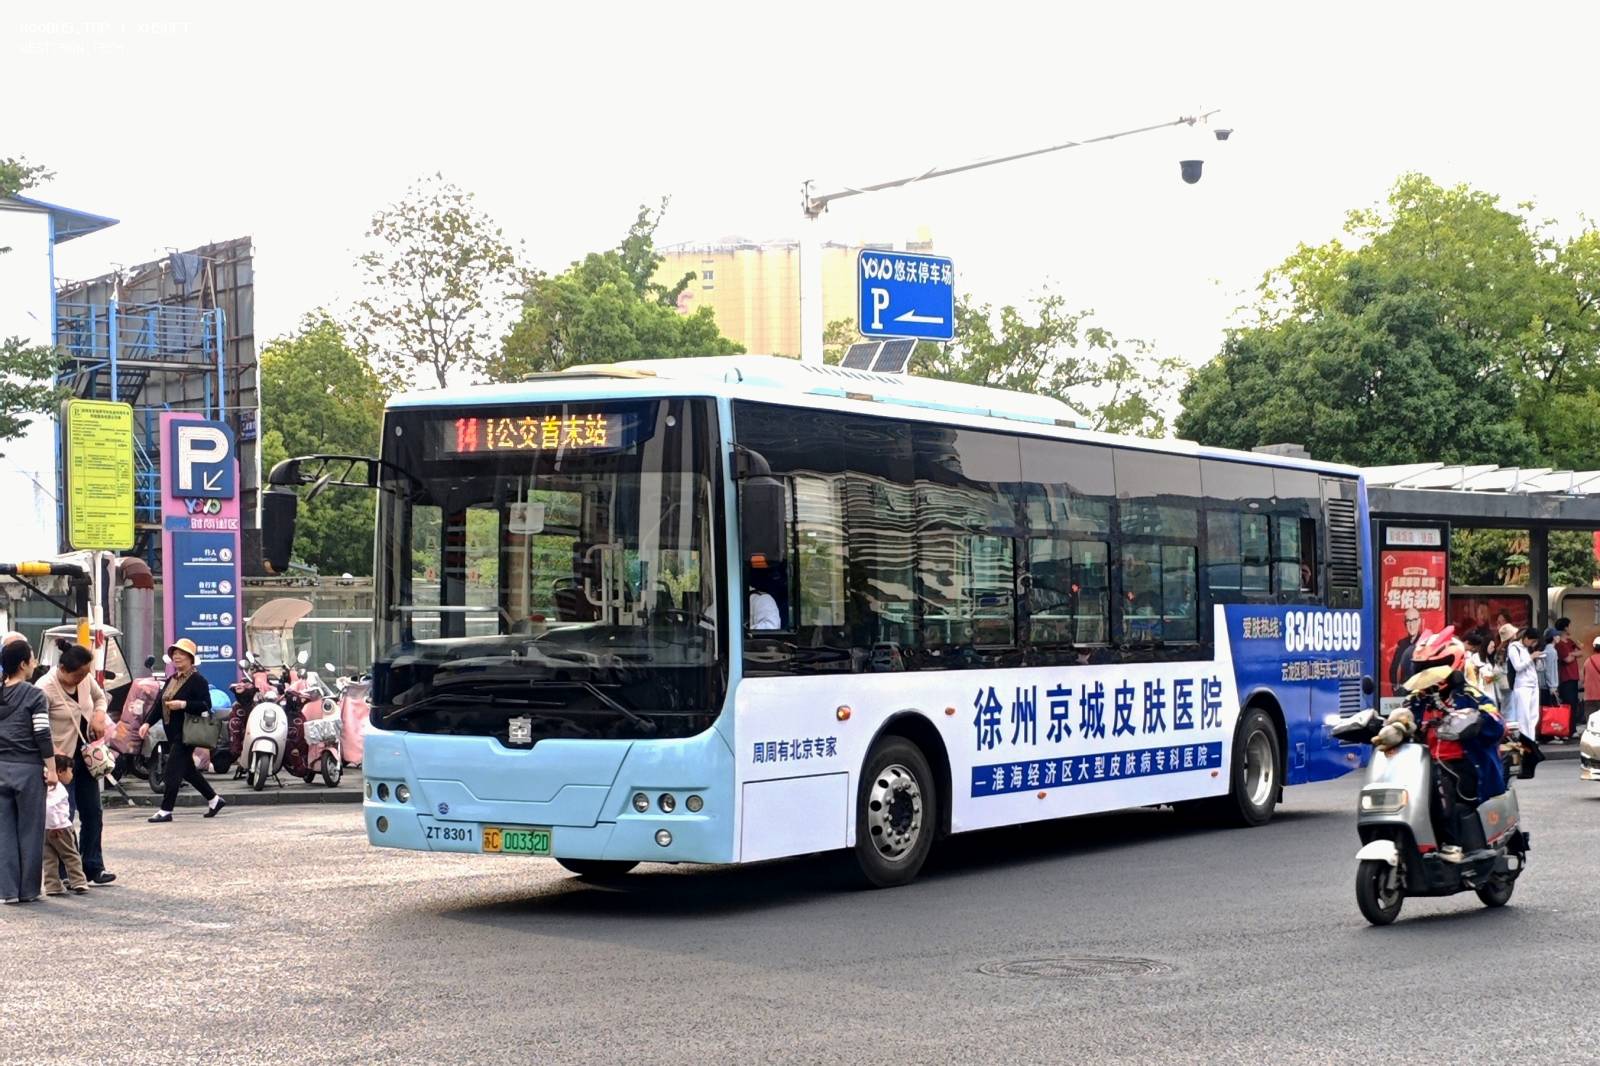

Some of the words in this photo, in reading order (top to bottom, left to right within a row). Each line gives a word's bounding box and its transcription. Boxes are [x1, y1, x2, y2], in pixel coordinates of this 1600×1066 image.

[894, 259, 952, 286] 悠沃停车场
[870, 287, 890, 330] P
[178, 426, 229, 490] P
[1285, 610, 1362, 653] 83469999
[973, 675, 1223, 751] 徐州京城皮肤医院
[752, 735, 838, 764] 周周有北京专家
[426, 826, 443, 839] ZT
[443, 827, 473, 842] 8301
[504, 832, 549, 852] 00332D
